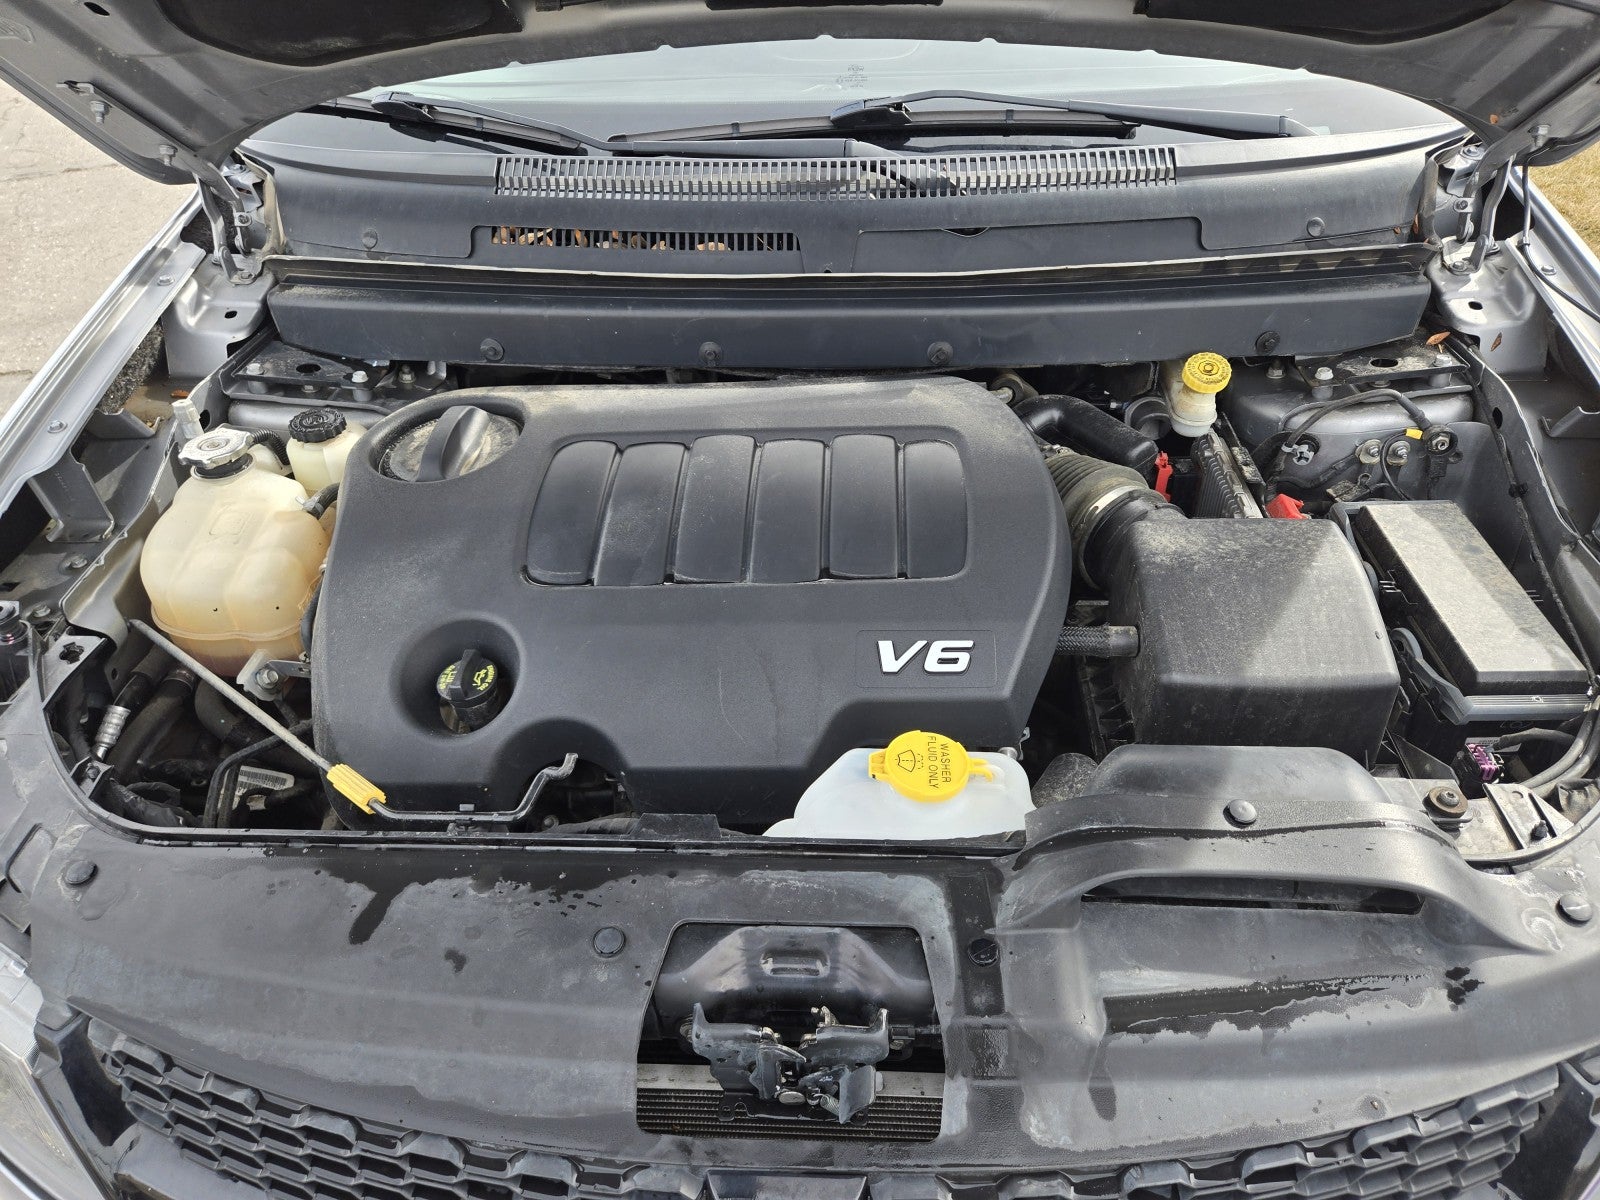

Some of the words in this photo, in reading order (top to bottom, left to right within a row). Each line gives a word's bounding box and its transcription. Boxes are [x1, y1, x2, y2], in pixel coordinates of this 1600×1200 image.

[877, 640, 975, 674] V6
[927, 735, 938, 762] FLUID
[940, 742, 952, 783] WASHER
[928, 764, 939, 789] ONLY
